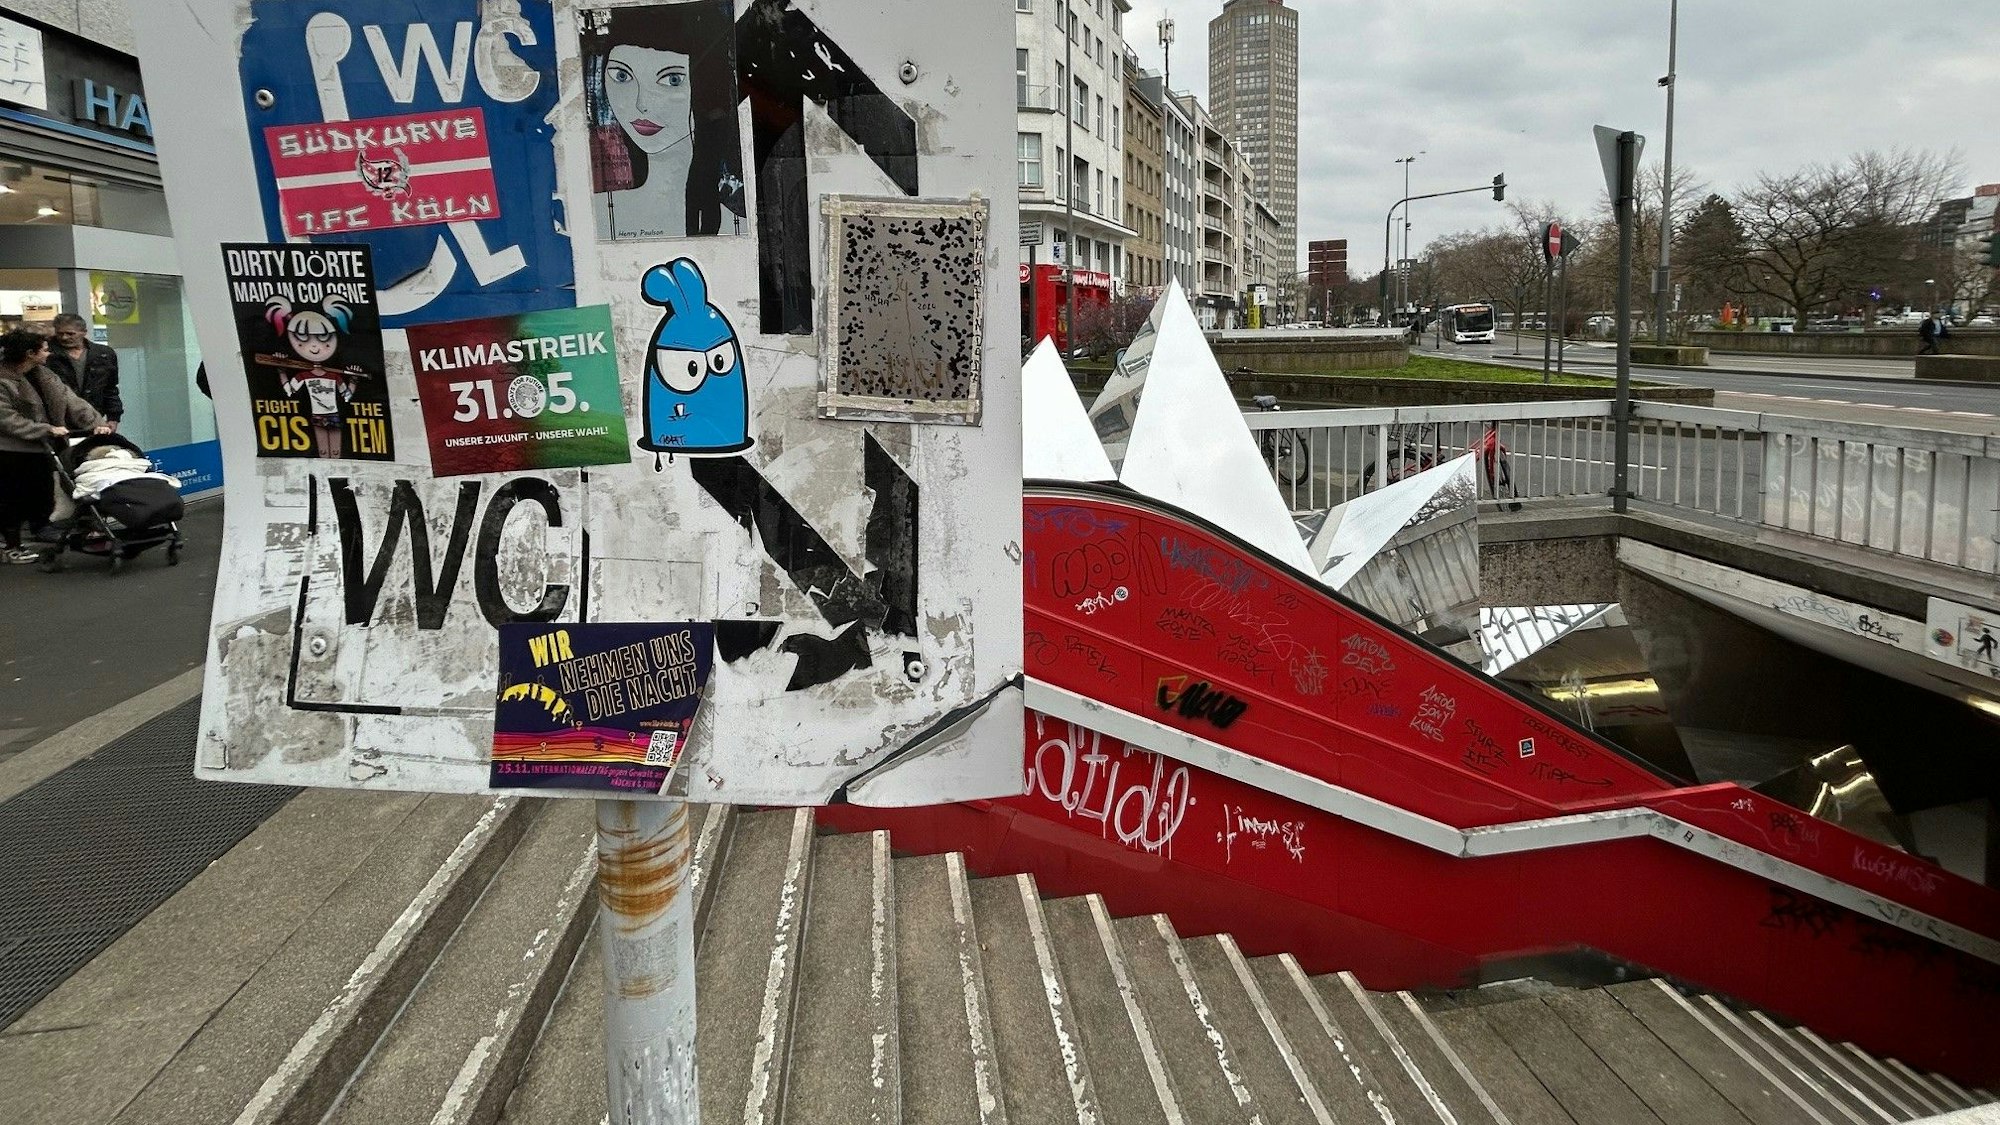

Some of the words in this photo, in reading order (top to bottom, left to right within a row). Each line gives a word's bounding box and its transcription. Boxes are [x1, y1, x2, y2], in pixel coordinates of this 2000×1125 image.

[363, 20, 541, 103] WC
[84, 78, 155, 136] HA
[278, 117, 478, 157] SÜDKURVE
[377, 167, 393, 183] 12
[298, 205, 370, 231] 1.FC
[391, 195, 492, 222] KÖLN
[227, 250, 286, 277] DIRTY
[291, 251, 366, 278] DÖRTE
[233, 282, 274, 303] MAID
[277, 282, 295, 303] IN
[297, 282, 369, 304] COLOGNE
[419, 331, 609, 371] KLIMASTREIK
[255, 400, 300, 414] FIGHT
[351, 402, 384, 416] THE
[449, 372, 590, 422] 31.05.
[258, 415, 311, 451] CIS
[346, 418, 388, 454] TEM
[445, 437, 484, 447] UNSERE
[485, 432, 530, 445] ZUKUNFT
[536, 429, 575, 440] UNSERE
[575, 426, 608, 438] WAHL!
[328, 475, 571, 633] WC
[528, 630, 574, 668] WIR
[558, 642, 649, 694] NEHMEN
[650, 629, 696, 669] UNS
[585, 682, 626, 721] DIE
[626, 662, 698, 711] NACHT
[497, 763, 531, 774] 25.11.
